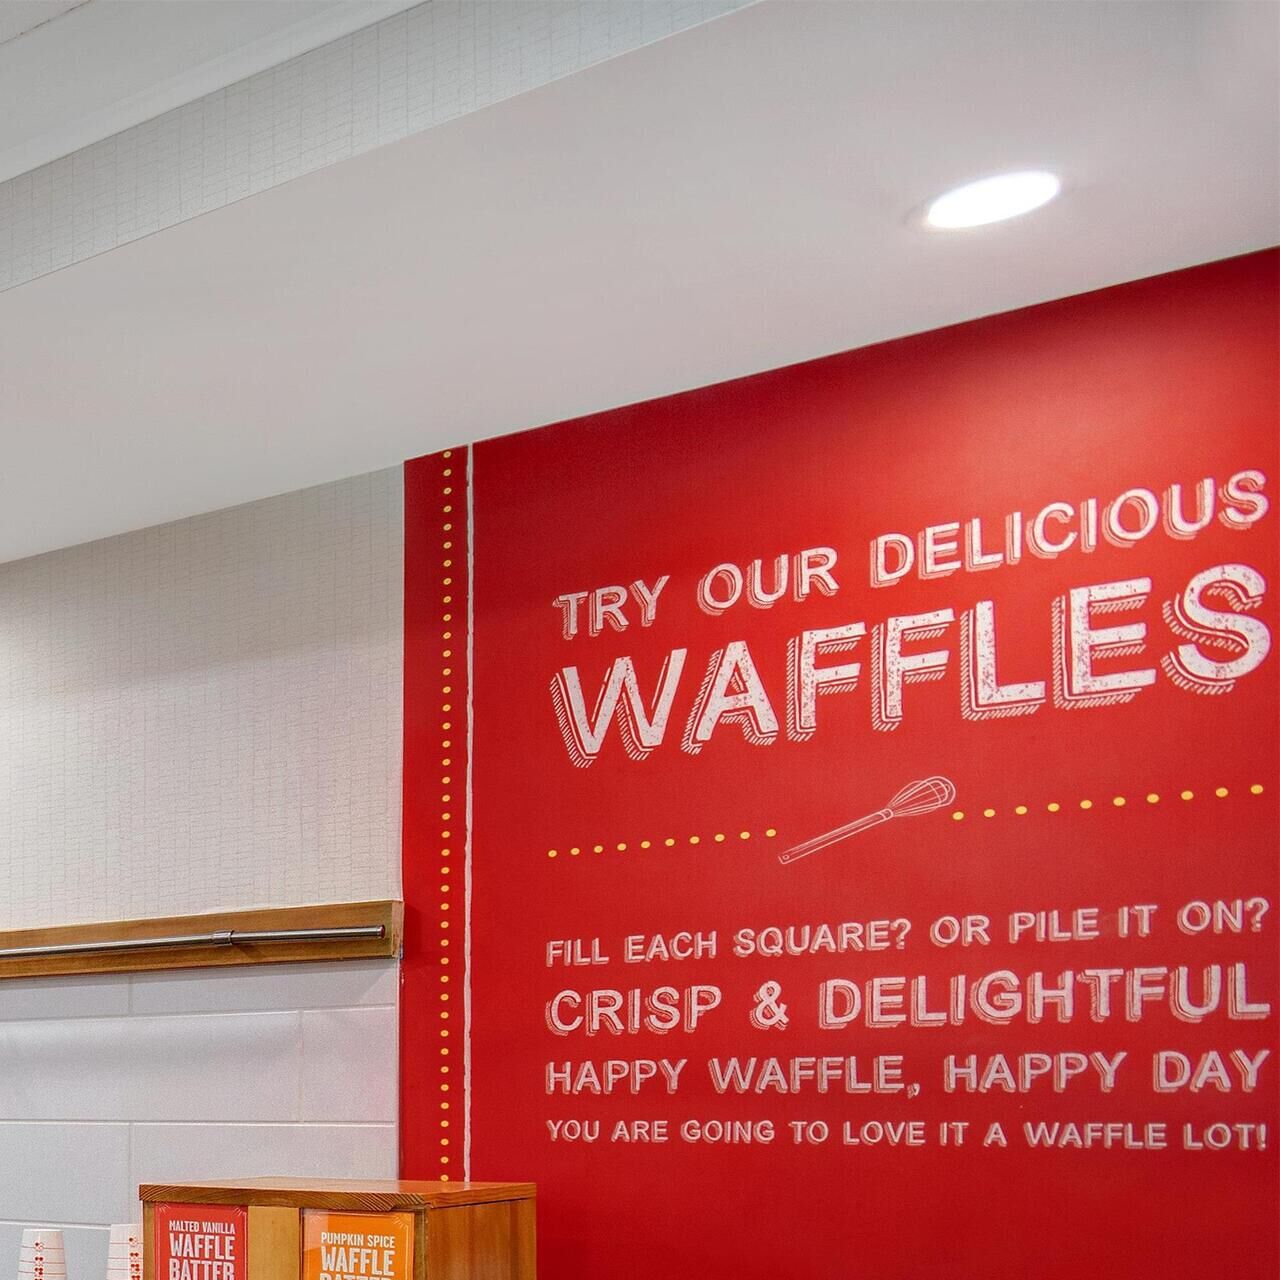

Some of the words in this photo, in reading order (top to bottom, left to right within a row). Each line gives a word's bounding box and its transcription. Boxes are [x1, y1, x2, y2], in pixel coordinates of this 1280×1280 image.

[553, 576, 669, 640] TRY
[697, 547, 838, 614] OUR
[870, 470, 1269, 589] DELICIOUS
[550, 563, 1272, 768] WAFFLES
[546, 939, 609, 966] FILL
[625, 931, 717, 963] EACH
[733, 918, 912, 956] SQUARE?
[930, 915, 990, 947] OR
[1009, 907, 1098, 943] PILE
[1117, 904, 1157, 938] IT
[1177, 897, 1269, 935] ON?
[545, 985, 721, 1036] CRISP
[753, 980, 790, 1030] &
[818, 963, 1271, 1028] DELIGHTFUL
[546, 1058, 687, 1095] HAPPY
[708, 1054, 921, 1098] WAFFLE,
[943, 1051, 1127, 1093] HAPPY
[1153, 1049, 1270, 1093] DAY
[546, 1120, 600, 1143] YOU
[610, 1120, 668, 1143] ARE
[680, 1120, 775, 1144] GOING
[792, 1121, 828, 1145] TO
[843, 1121, 925, 1146] LOVE
[940, 1122, 969, 1147] IT
[983, 1122, 1008, 1147] A
[1023, 1122, 1167, 1149] WAFFLE
[1183, 1123, 1267, 1150] LOT!
[169, 1220, 199, 1232] MALTED
[202, 1221, 235, 1234] VANILLA
[169, 1233, 235, 1260] WAFFLE
[321, 1232, 364, 1246] PUMPKIN
[367, 1235, 395, 1248] SPICE
[321, 1246, 395, 1276] WAFFLE
